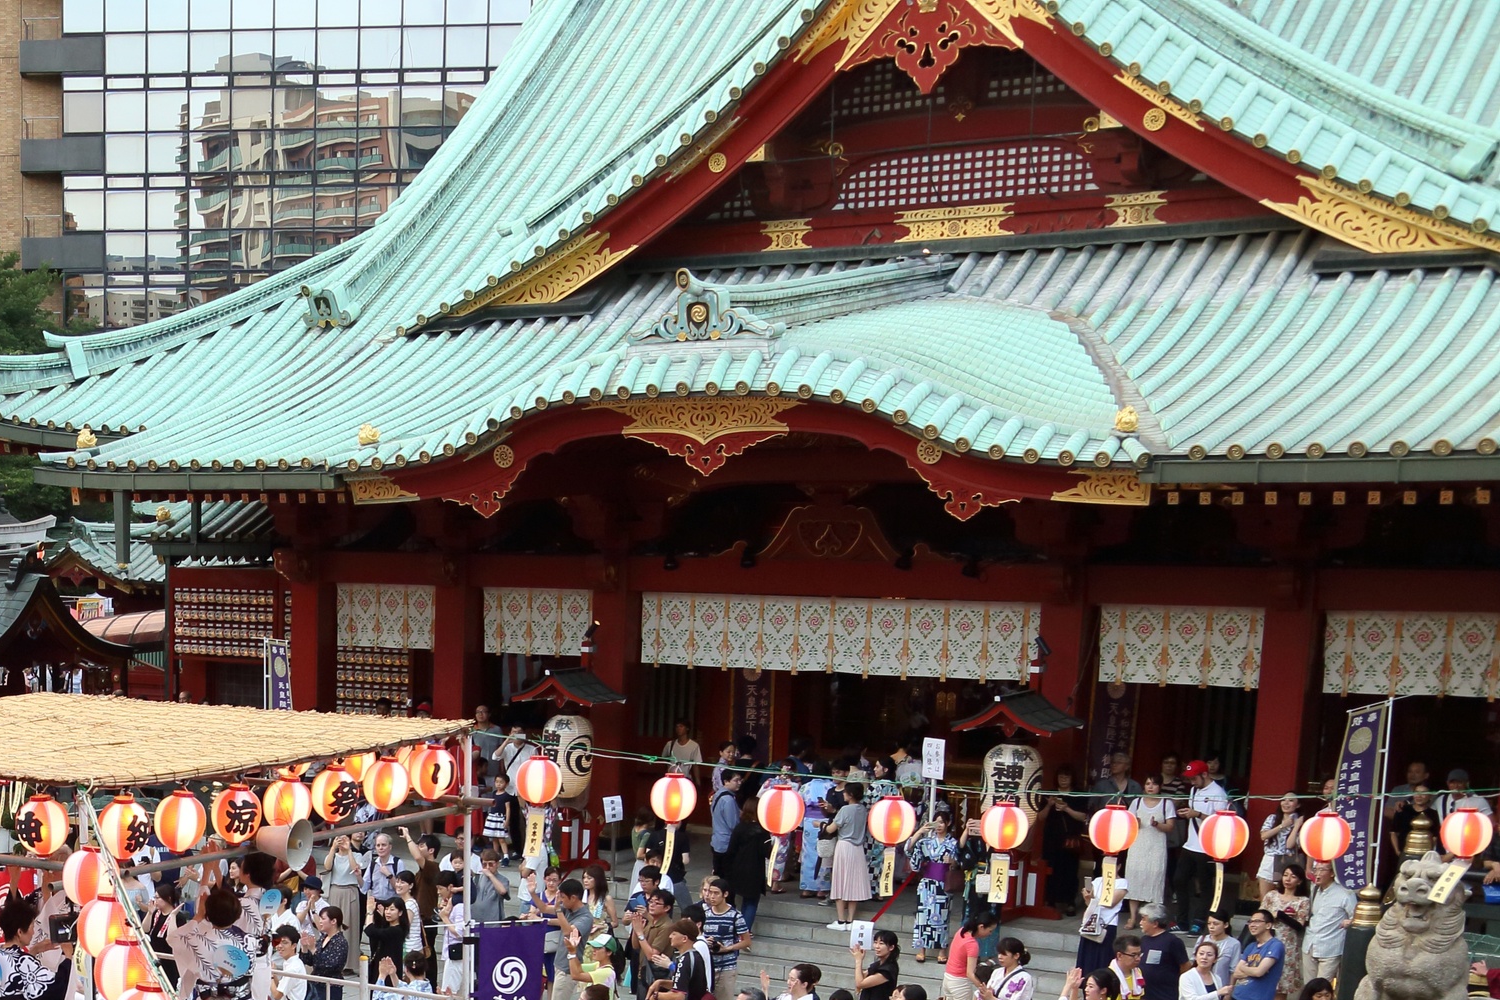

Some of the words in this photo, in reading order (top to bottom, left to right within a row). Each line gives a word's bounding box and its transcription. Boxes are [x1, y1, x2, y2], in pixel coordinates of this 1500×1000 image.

[759, 687, 769, 726] 令和元年
[431, 754, 454, 791] り
[330, 781, 360, 816] 祭
[224, 800, 258, 836] 涼
[994, 867, 1004, 899] にんべん
[1102, 871, 1113, 903] にんべん
